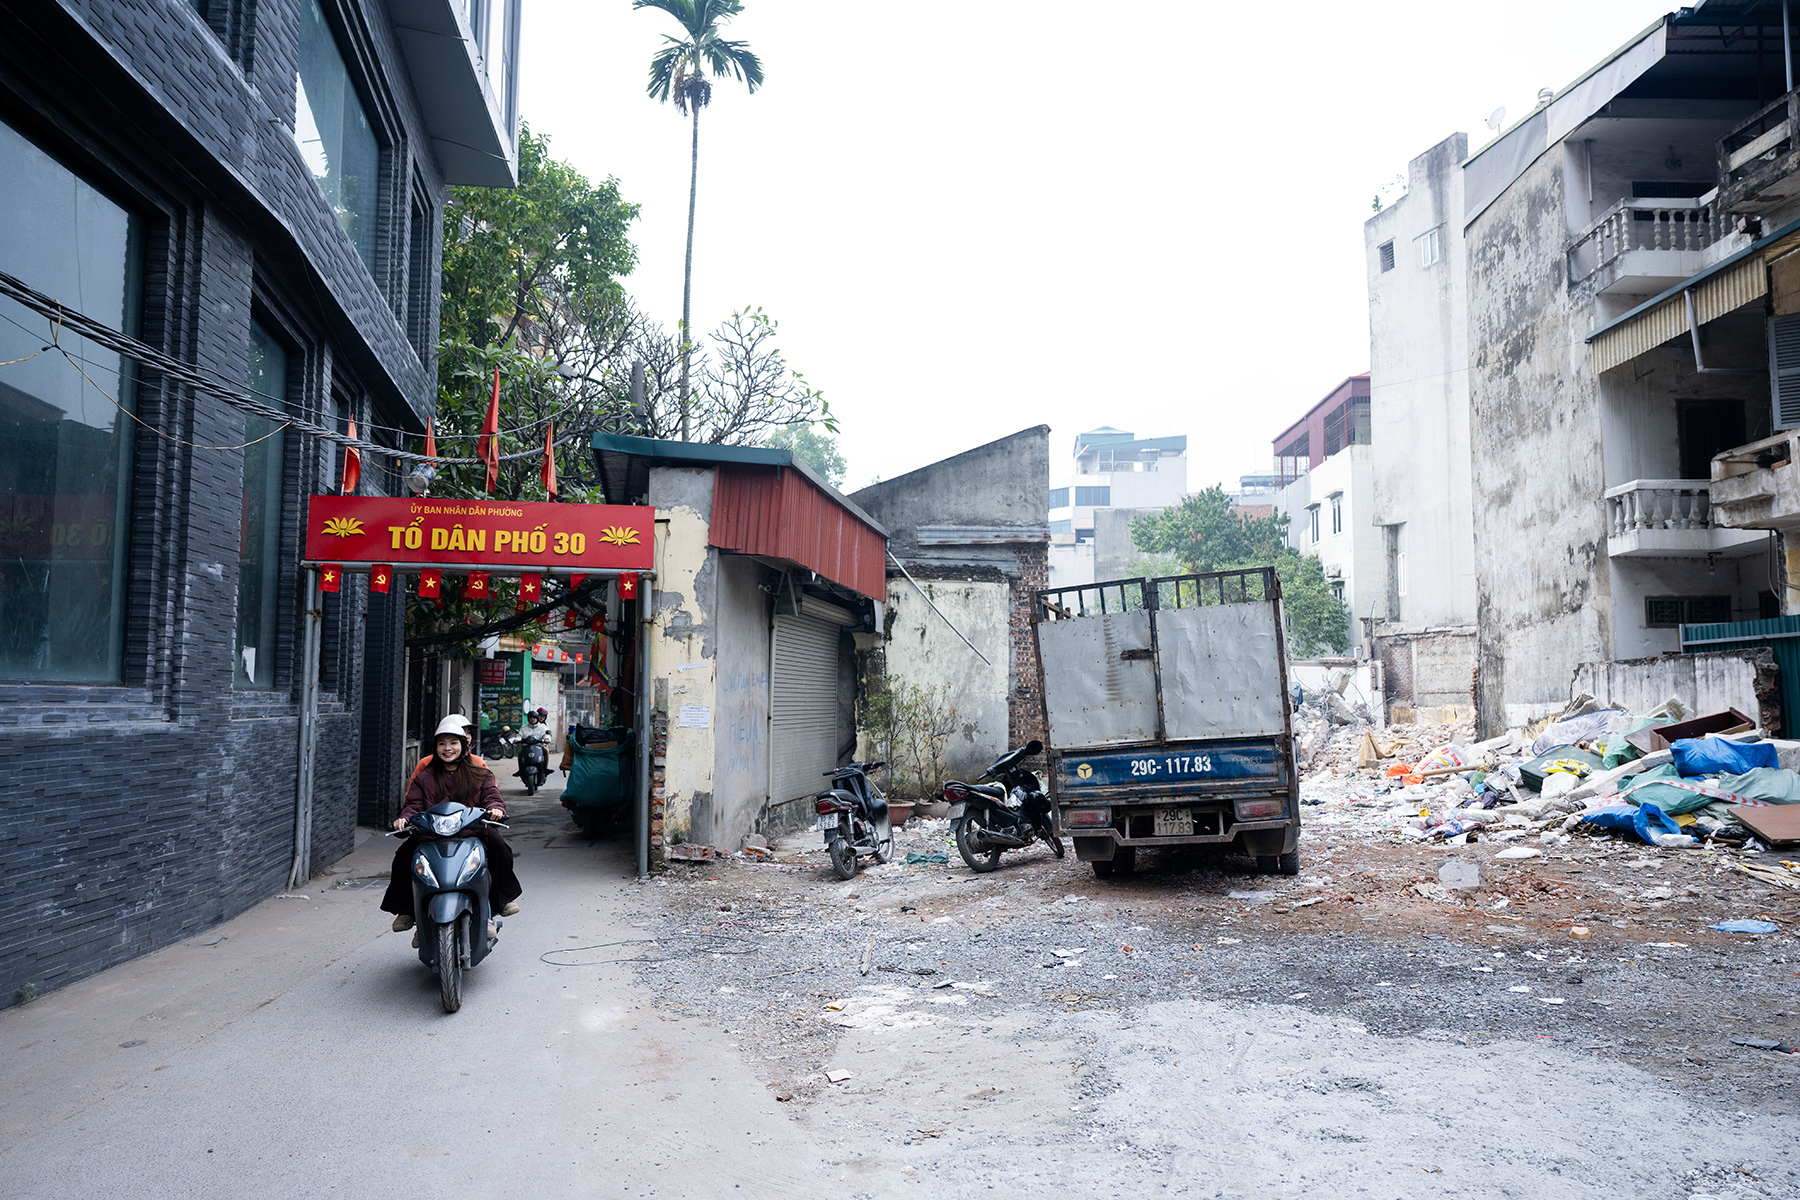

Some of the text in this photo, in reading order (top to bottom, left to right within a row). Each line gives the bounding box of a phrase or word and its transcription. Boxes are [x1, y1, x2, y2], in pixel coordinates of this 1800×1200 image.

[410, 503, 523, 517] ỦY BAN NHÂN DÂN PHƯỜNG
[388, 516, 586, 555] TỔ DÂN PHỐ 30
[1165, 756, 1211, 774] 117.83
[1162, 809, 1183, 822] 29C
[1157, 821, 1192, 835] 117.83
